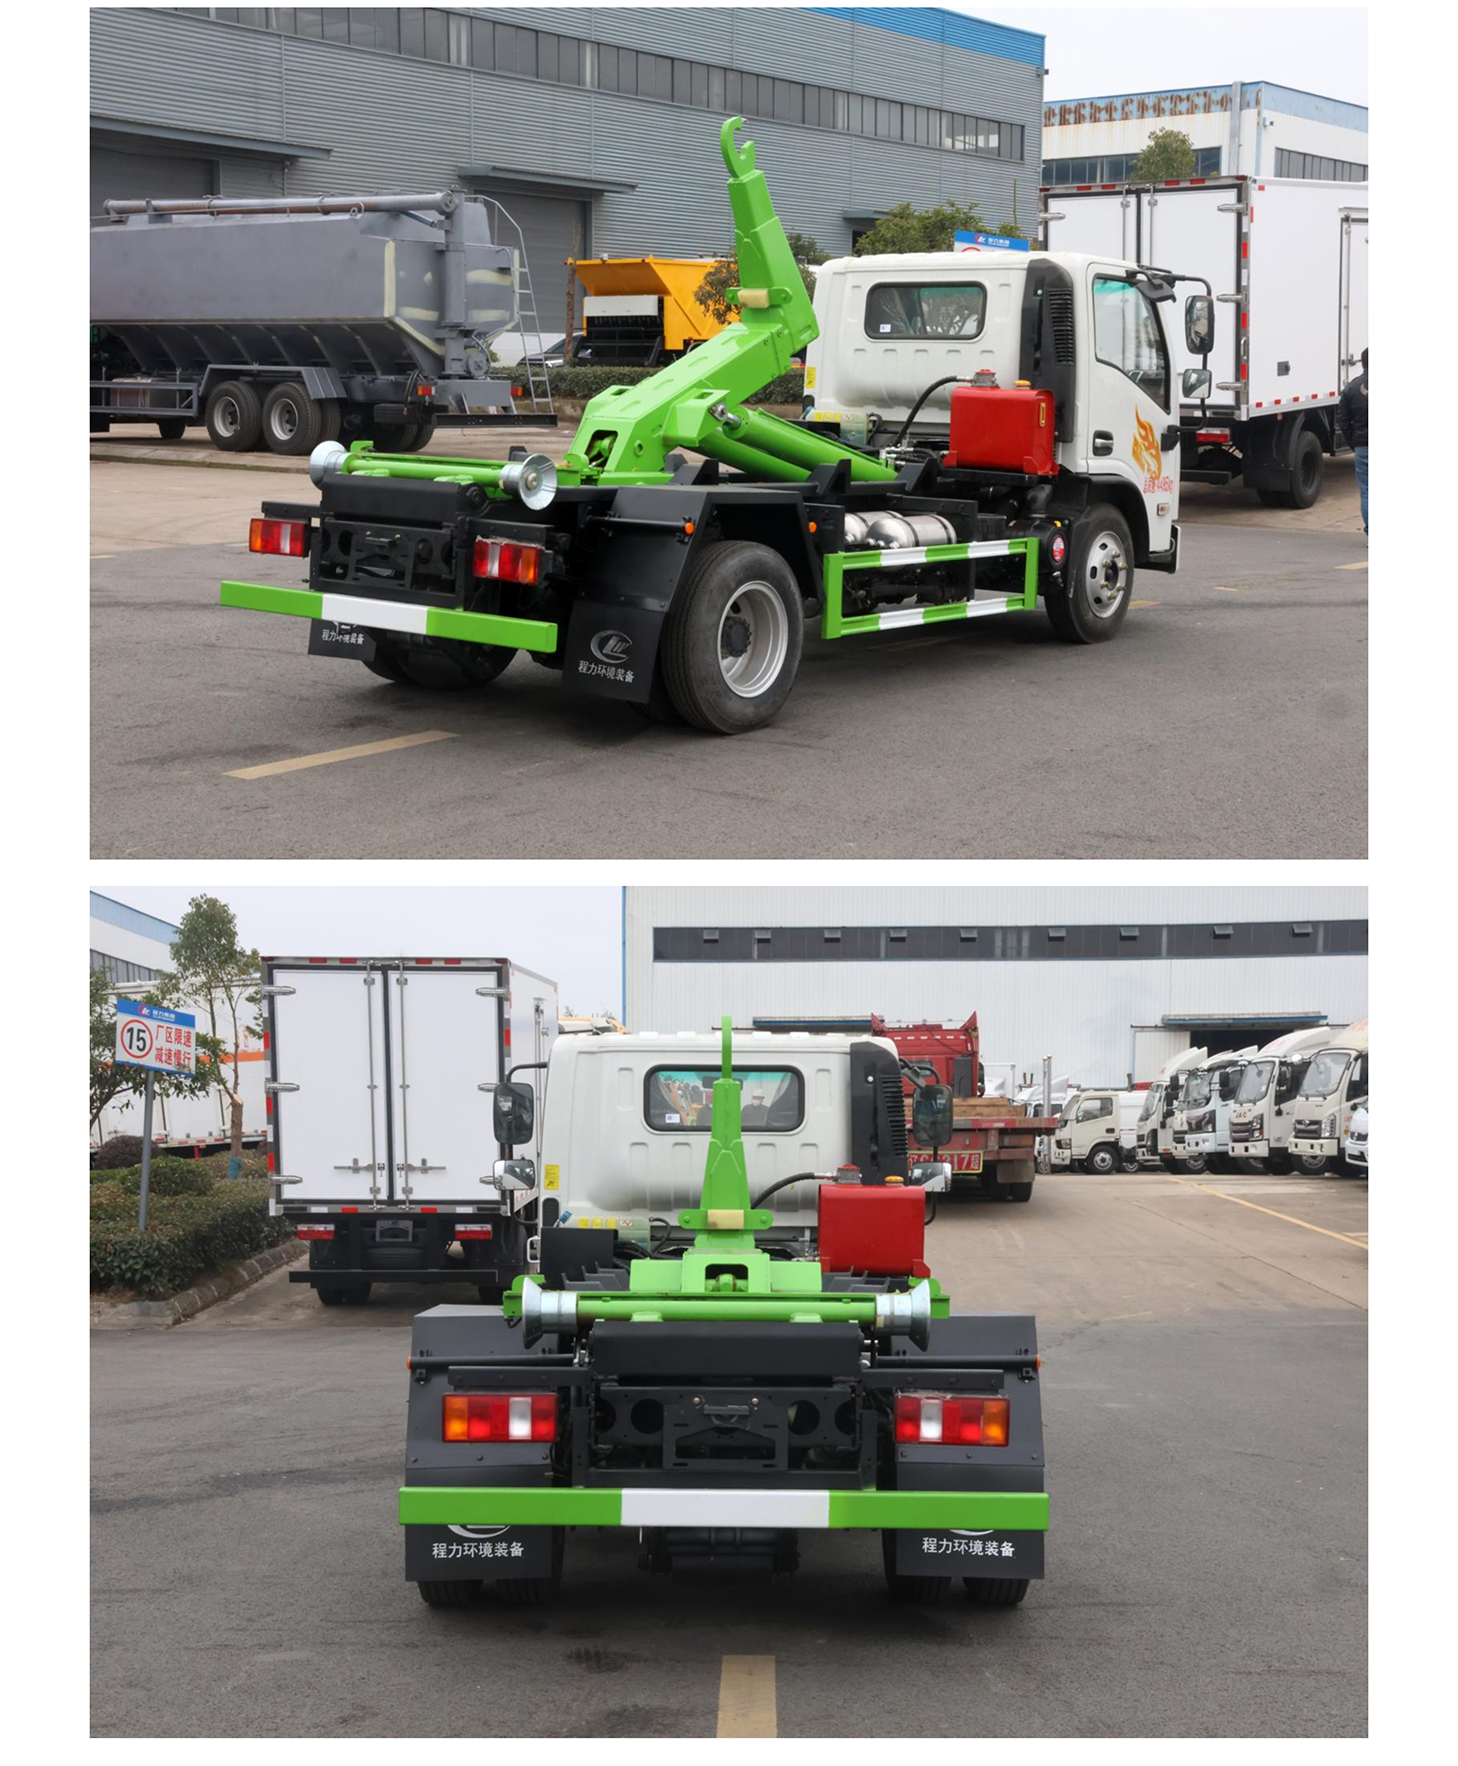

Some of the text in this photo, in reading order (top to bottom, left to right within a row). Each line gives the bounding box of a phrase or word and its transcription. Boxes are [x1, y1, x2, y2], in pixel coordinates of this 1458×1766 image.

[578, 660, 635, 683] 程力环境装备
[126, 1026, 147, 1052] 15
[155, 1024, 192, 1048] 厂区限速
[154, 1046, 192, 1067] 减速慢行
[432, 1541, 525, 1559] 程力环境装备
[922, 1537, 1015, 1557] 程力环境装备
